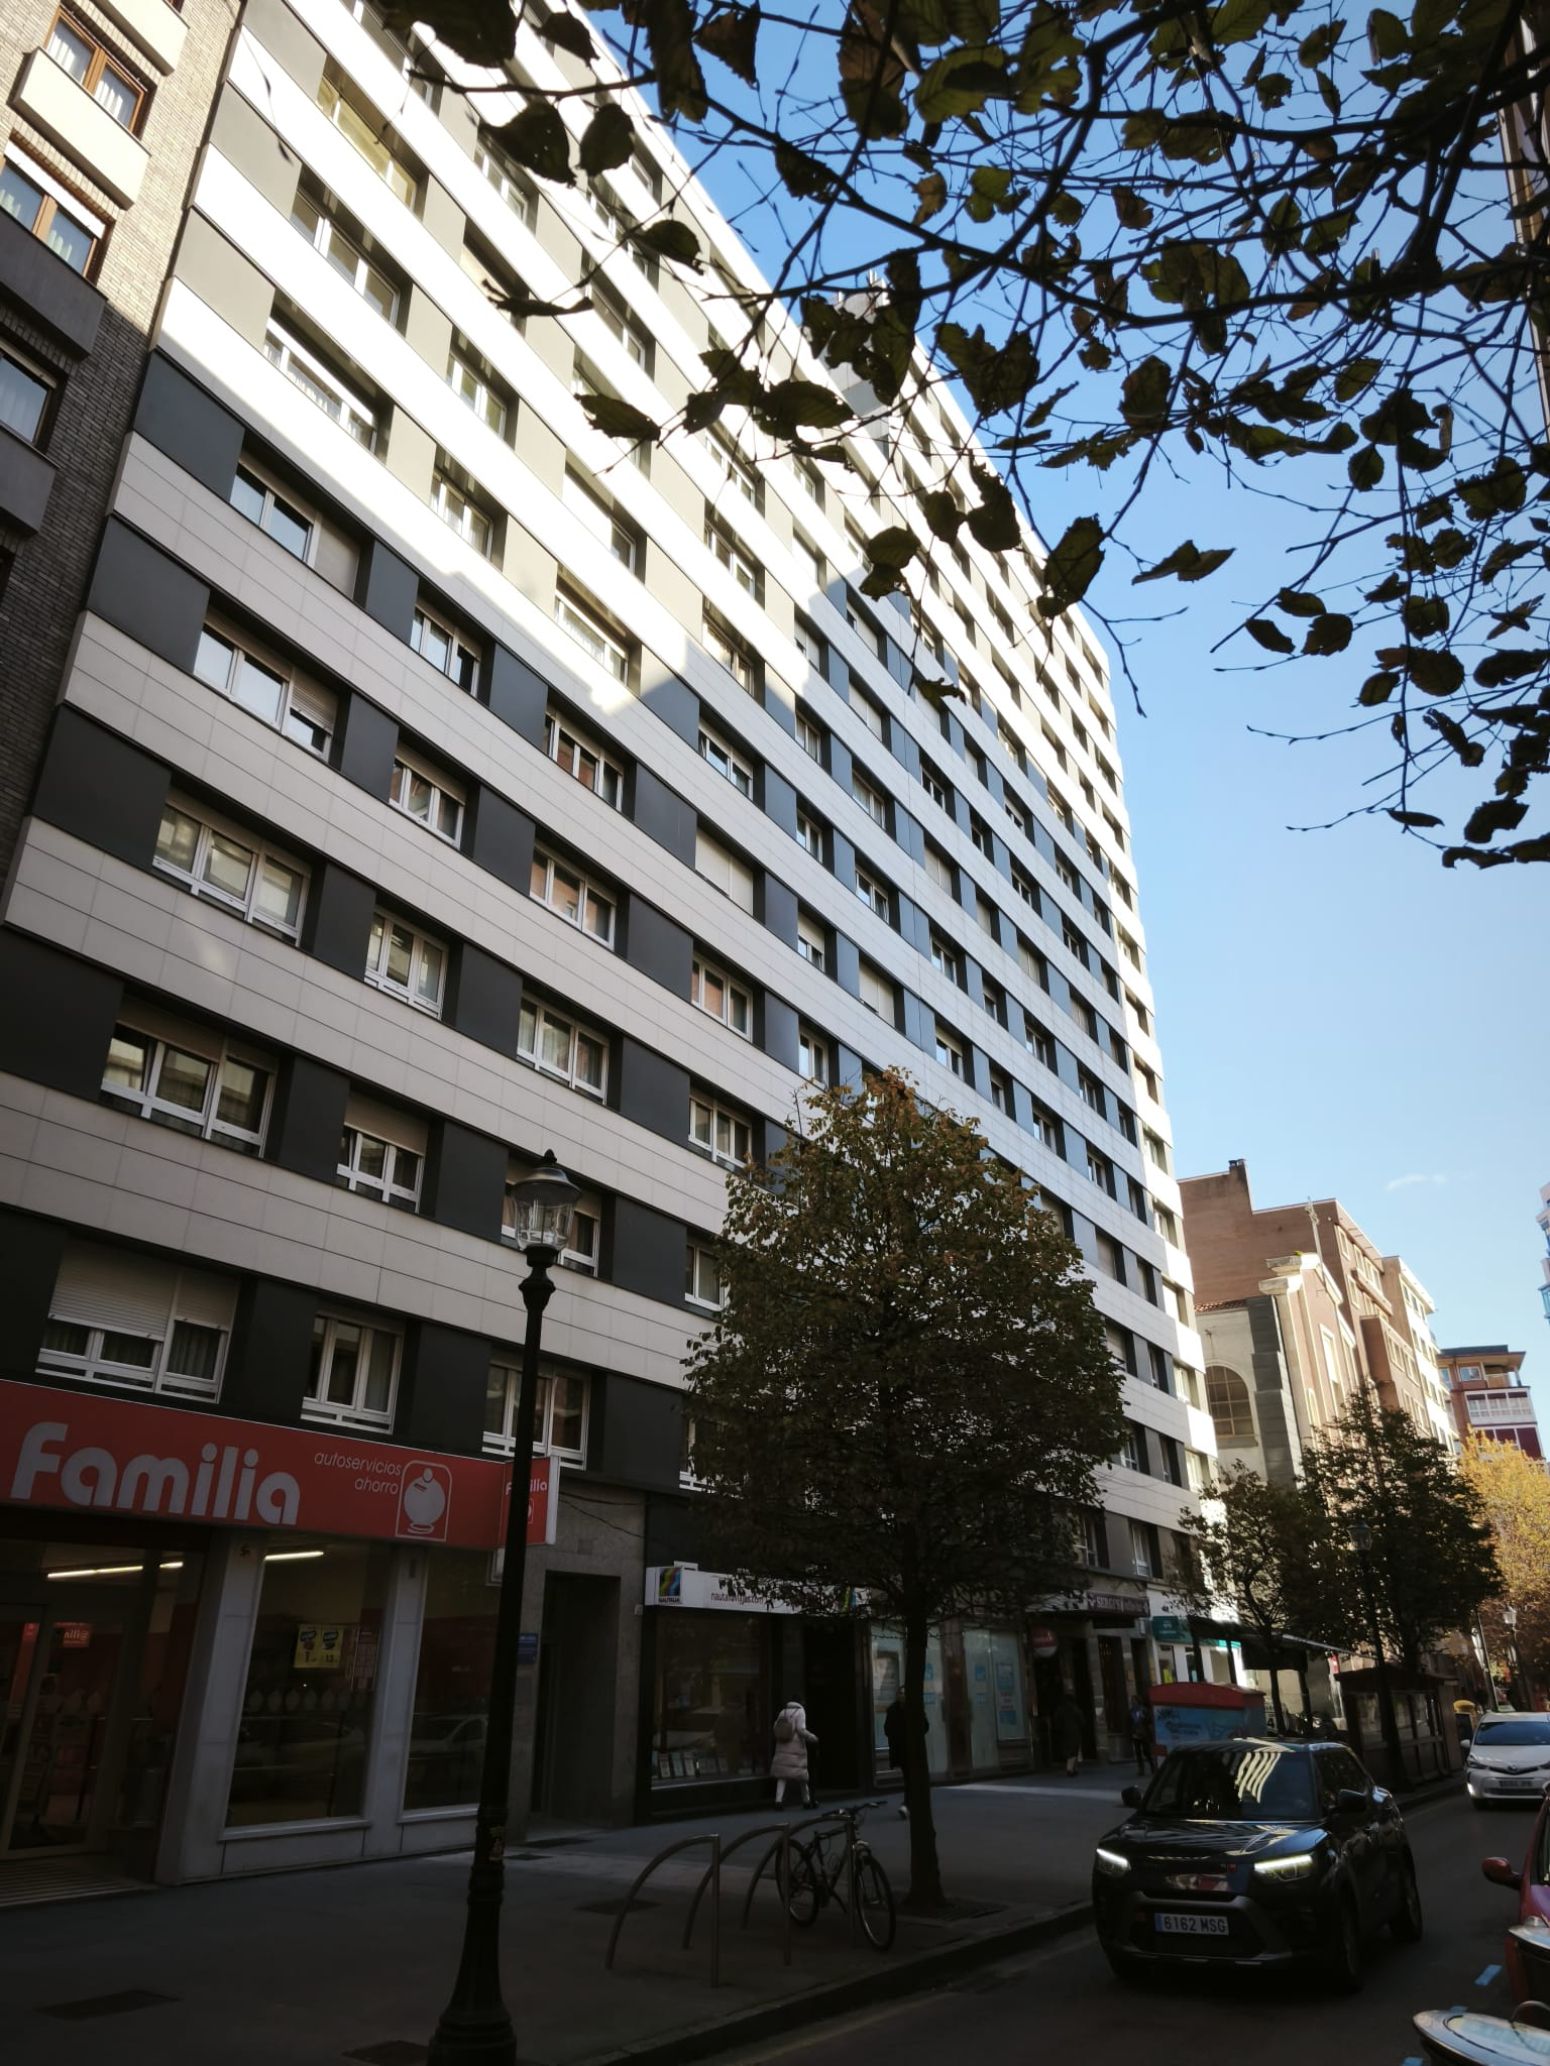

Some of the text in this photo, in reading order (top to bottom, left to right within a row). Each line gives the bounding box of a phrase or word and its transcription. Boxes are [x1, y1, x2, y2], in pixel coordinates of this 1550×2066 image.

[10, 1421, 300, 1525] Familia
[314, 1451, 402, 1477] autoservicios
[354, 1477, 399, 1496] ahorro
[505, 1477, 548, 1496] Filia
[1163, 1915, 1227, 1933] 6162 MSG
